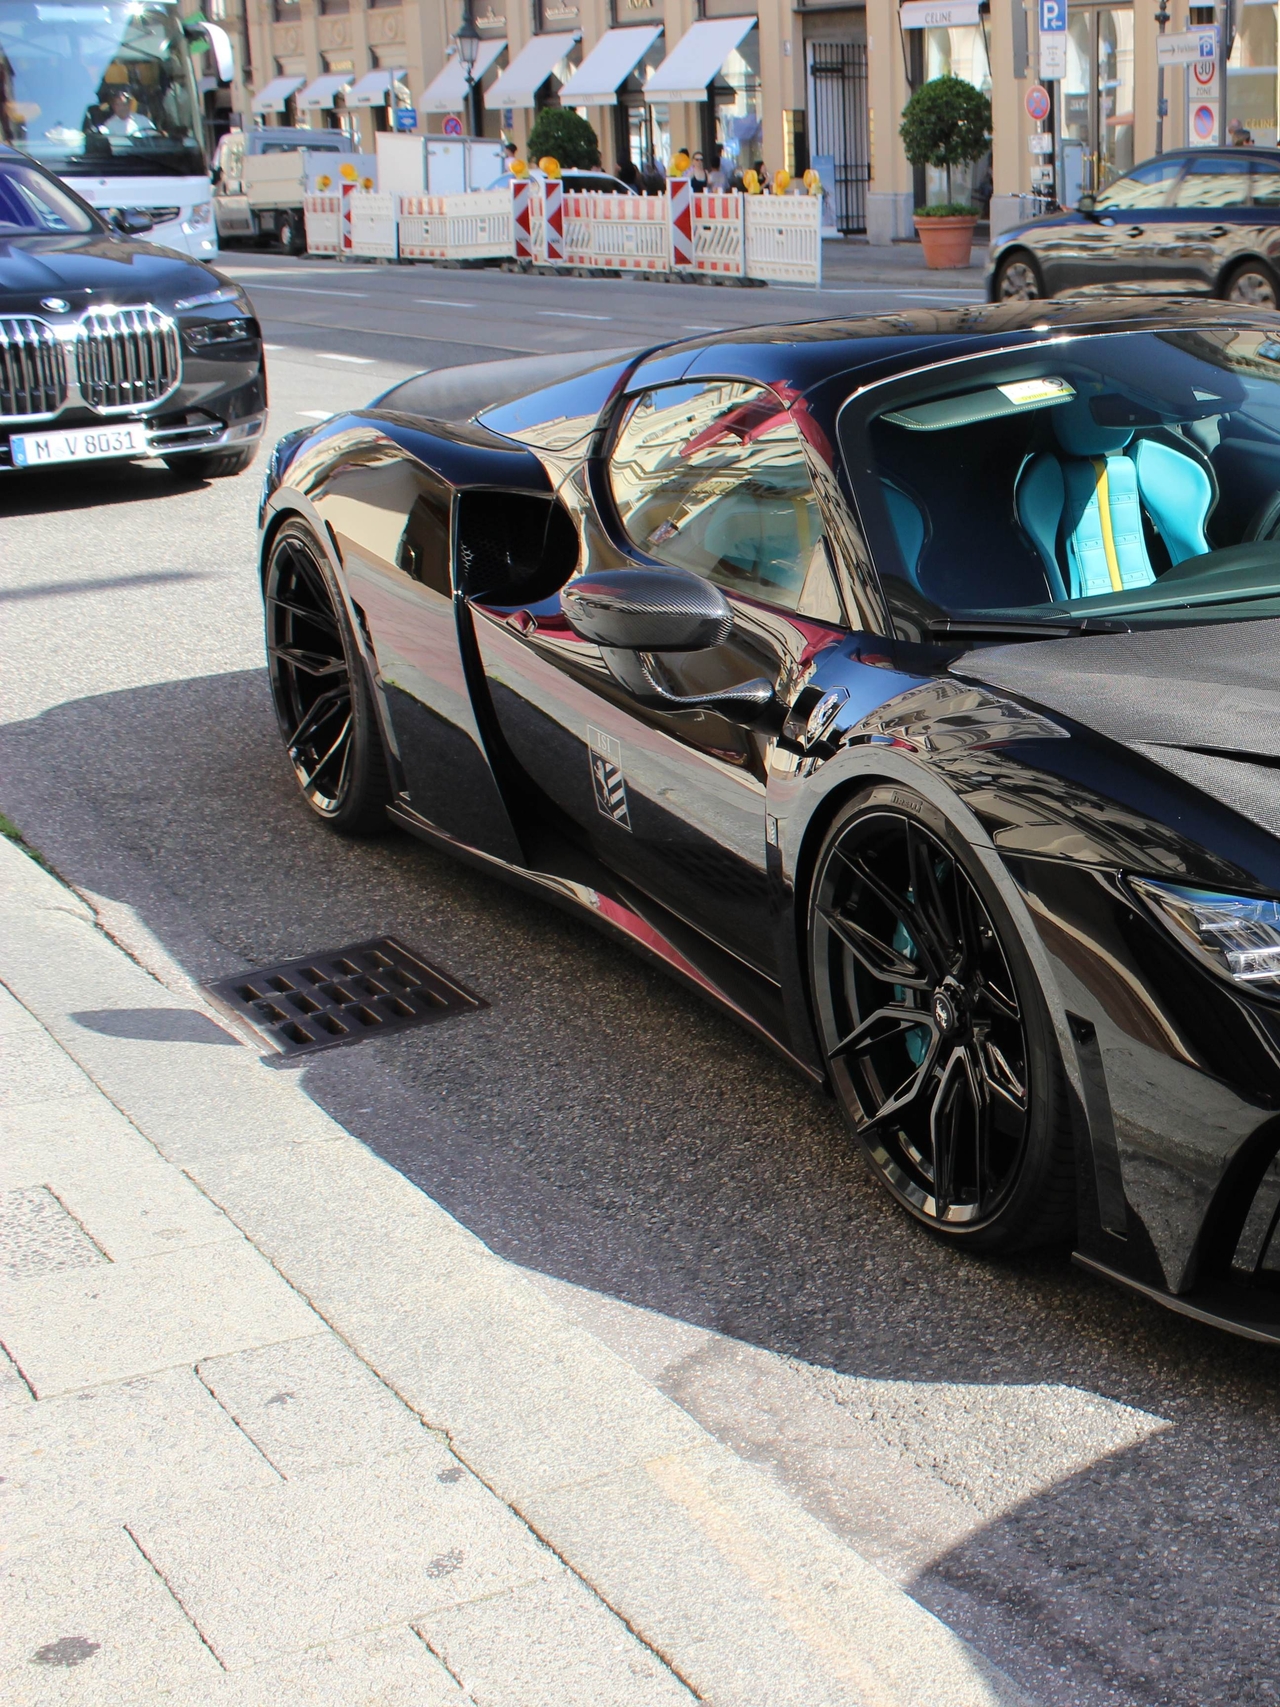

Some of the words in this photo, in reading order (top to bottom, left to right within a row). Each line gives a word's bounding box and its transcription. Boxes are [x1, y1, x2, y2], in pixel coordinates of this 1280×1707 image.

[924, 11, 952, 25] CELINE
[1043, 1, 1059, 30] P
[1198, 62, 1211, 75] 30
[1196, 86, 1212, 96] ZONE
[35, 439, 51, 459] M
[65, 436, 77, 456] V
[84, 431, 136, 454] 8031
[597, 732, 611, 753] ISI
